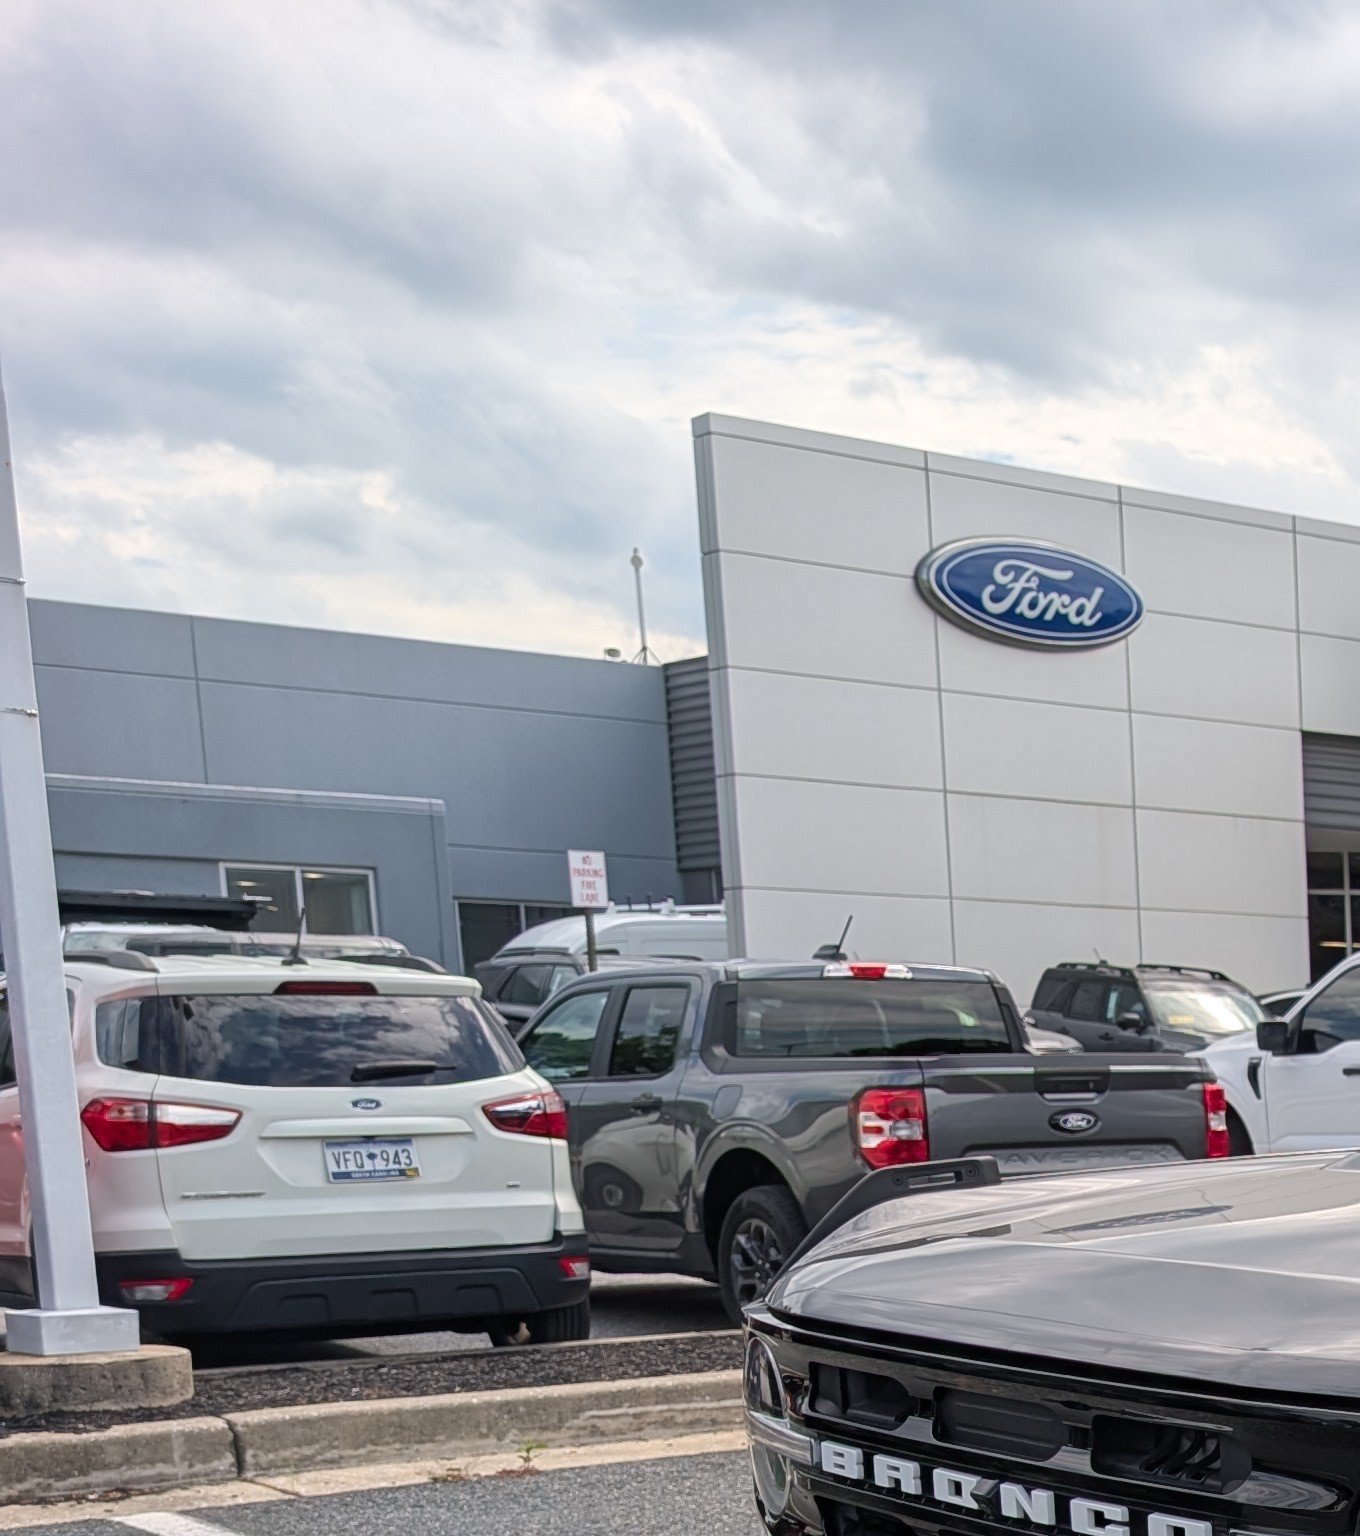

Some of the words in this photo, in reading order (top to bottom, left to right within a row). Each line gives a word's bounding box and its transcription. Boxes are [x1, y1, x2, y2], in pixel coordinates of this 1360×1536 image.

[980, 558, 1104, 627] Ford
[331, 1150, 365, 1170] VFQ
[380, 1148, 413, 1167] 943
